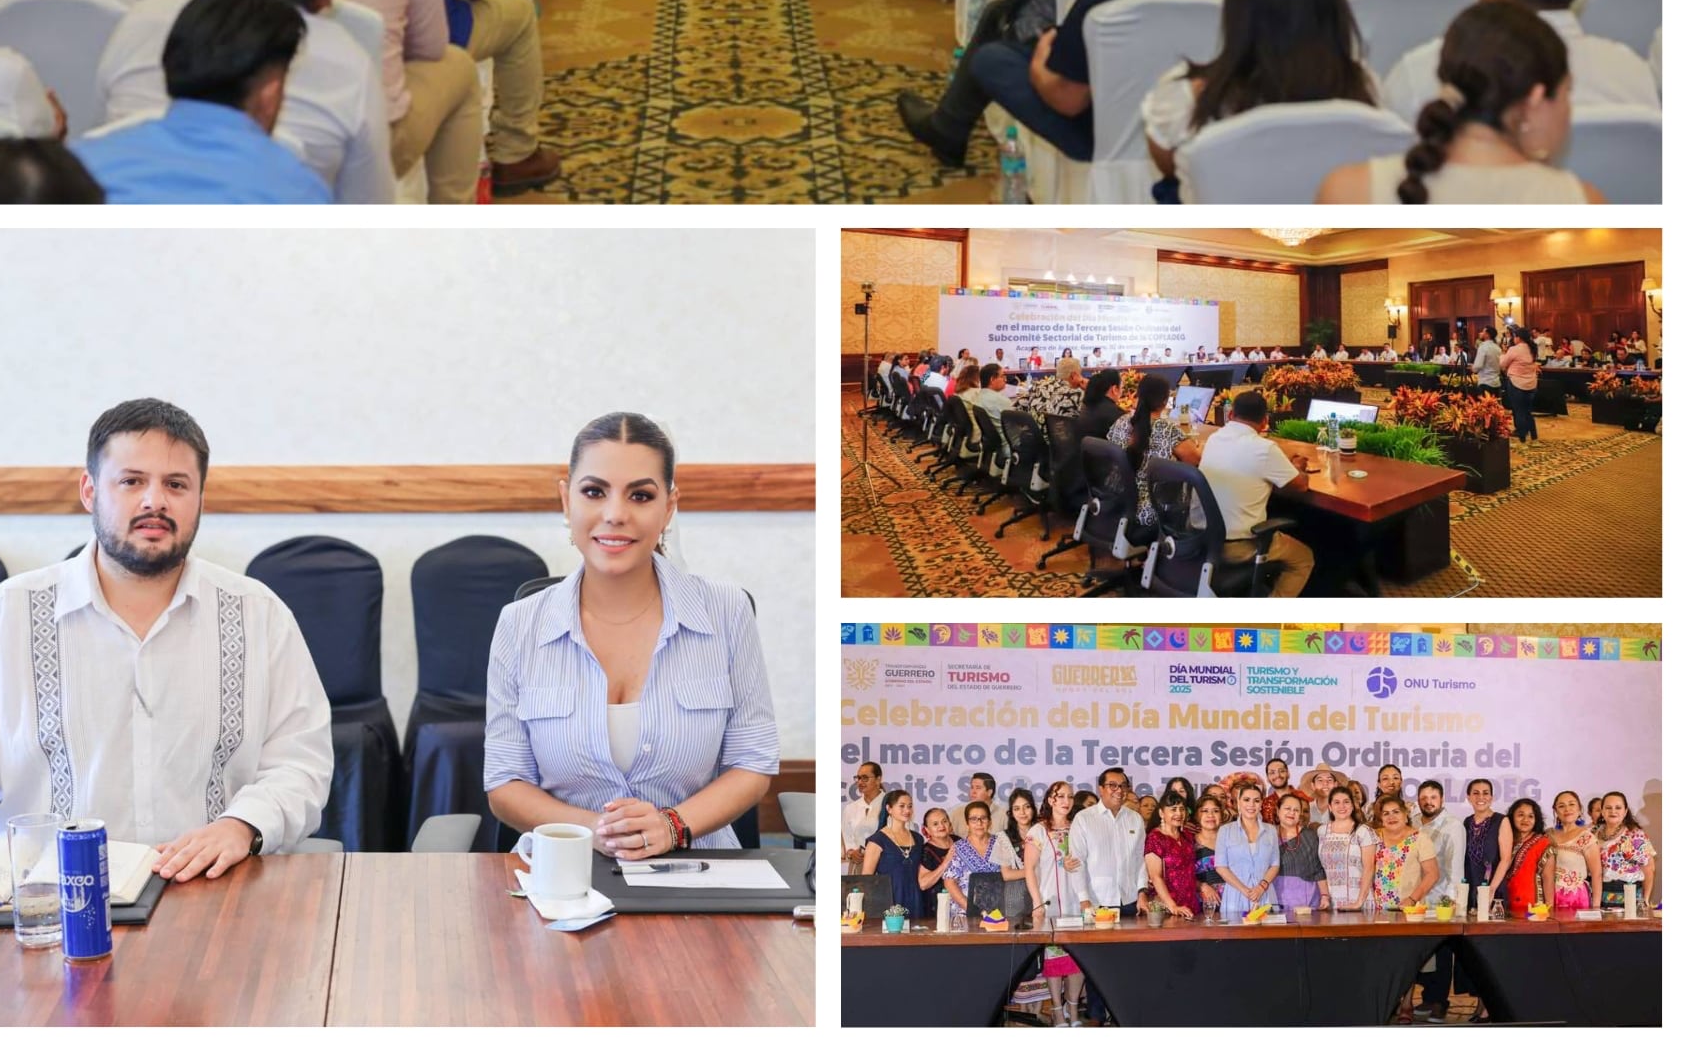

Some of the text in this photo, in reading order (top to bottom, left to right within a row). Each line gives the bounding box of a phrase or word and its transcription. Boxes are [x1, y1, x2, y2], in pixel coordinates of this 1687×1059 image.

[1010, 323, 1020, 331] el
[1021, 324, 1051, 332] marco
[1052, 323, 1064, 332] de
[1066, 323, 1075, 332] la
[1076, 324, 1107, 332] Tercera
[988, 333, 1041, 342] Subcomité
[1042, 333, 1082, 342] Sectorial
[1083, 333, 1095, 342] de
[885, 669, 935, 678] GUERRERO
[1169, 663, 1236, 675] DÍA MUNDIAL
[1246, 666, 1299, 676] TURISMO Y
[947, 671, 1010, 683] TURISMO
[1169, 675, 1189, 684] DEL
[1246, 675, 1338, 686] TRANSFORMACIÓN
[1403, 678, 1476, 690] ONU Turismo
[1169, 685, 1192, 694] 2025
[1246, 685, 1305, 695] SOSTENIBLE
[841, 699, 1484, 734] Celebración del Día Mundial del Turismo
[841, 737, 1521, 769] el marco de la Tercera Sesión Ordinaria del
